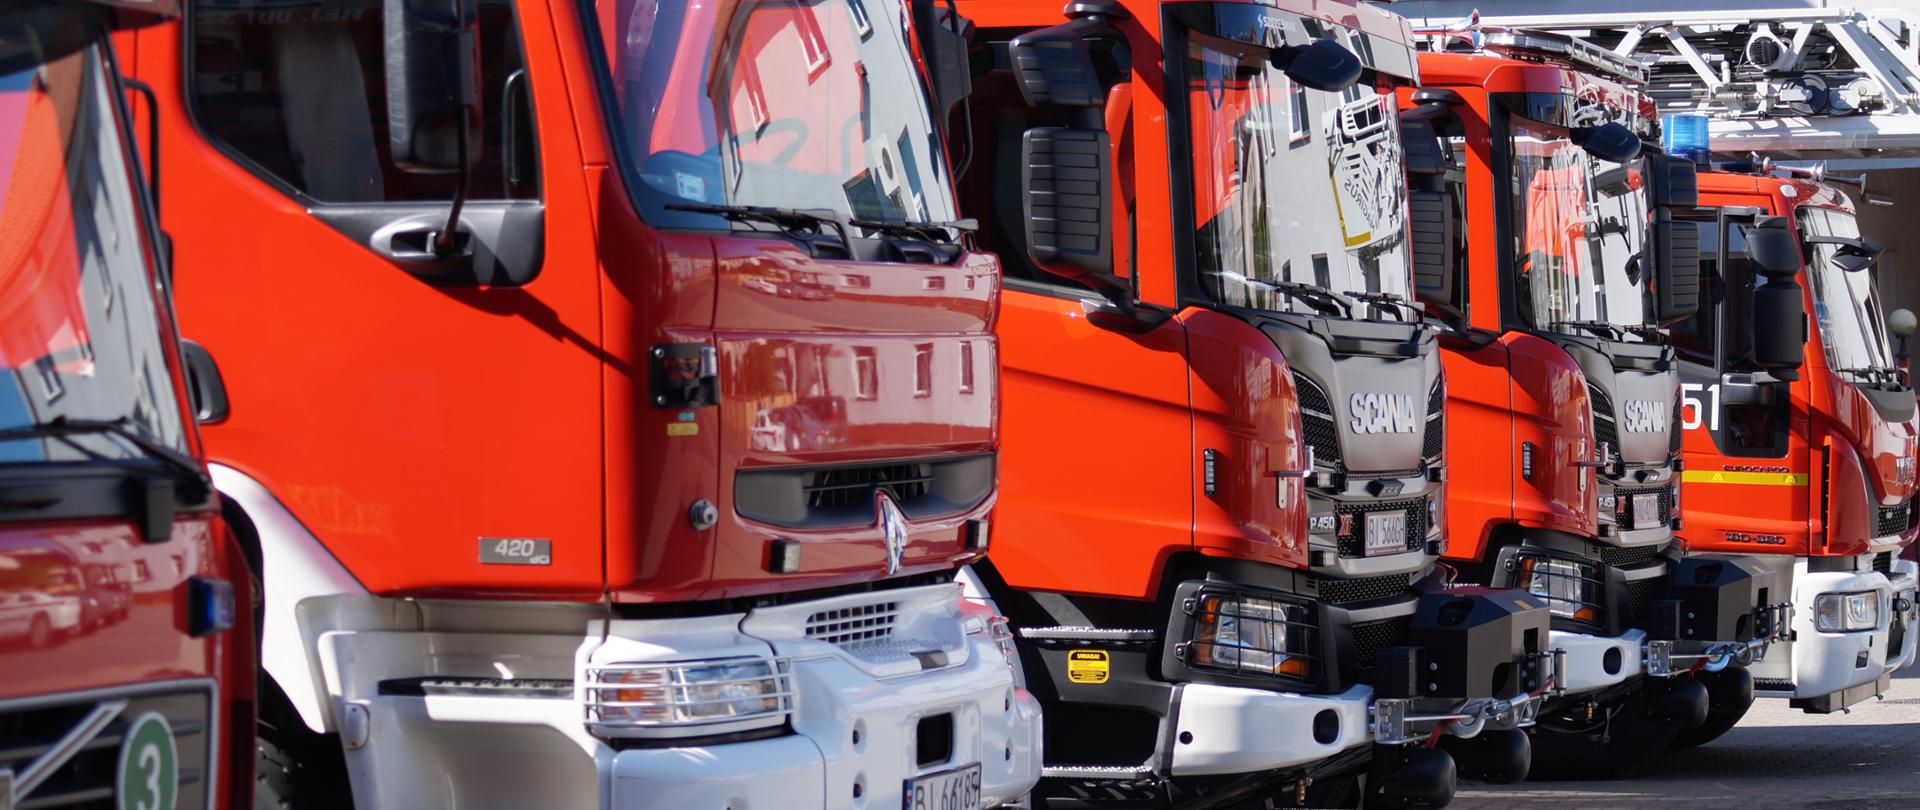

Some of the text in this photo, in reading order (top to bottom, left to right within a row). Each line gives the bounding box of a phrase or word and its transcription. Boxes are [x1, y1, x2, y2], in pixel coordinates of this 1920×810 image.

[1350, 392, 1416, 434] SCANIA
[1625, 400, 1665, 433] SCANIA
[1681, 383, 1720, 431] 51
[495, 539, 534, 556] 420
[137, 743, 162, 810] 3
[941, 771, 978, 810] 66185
